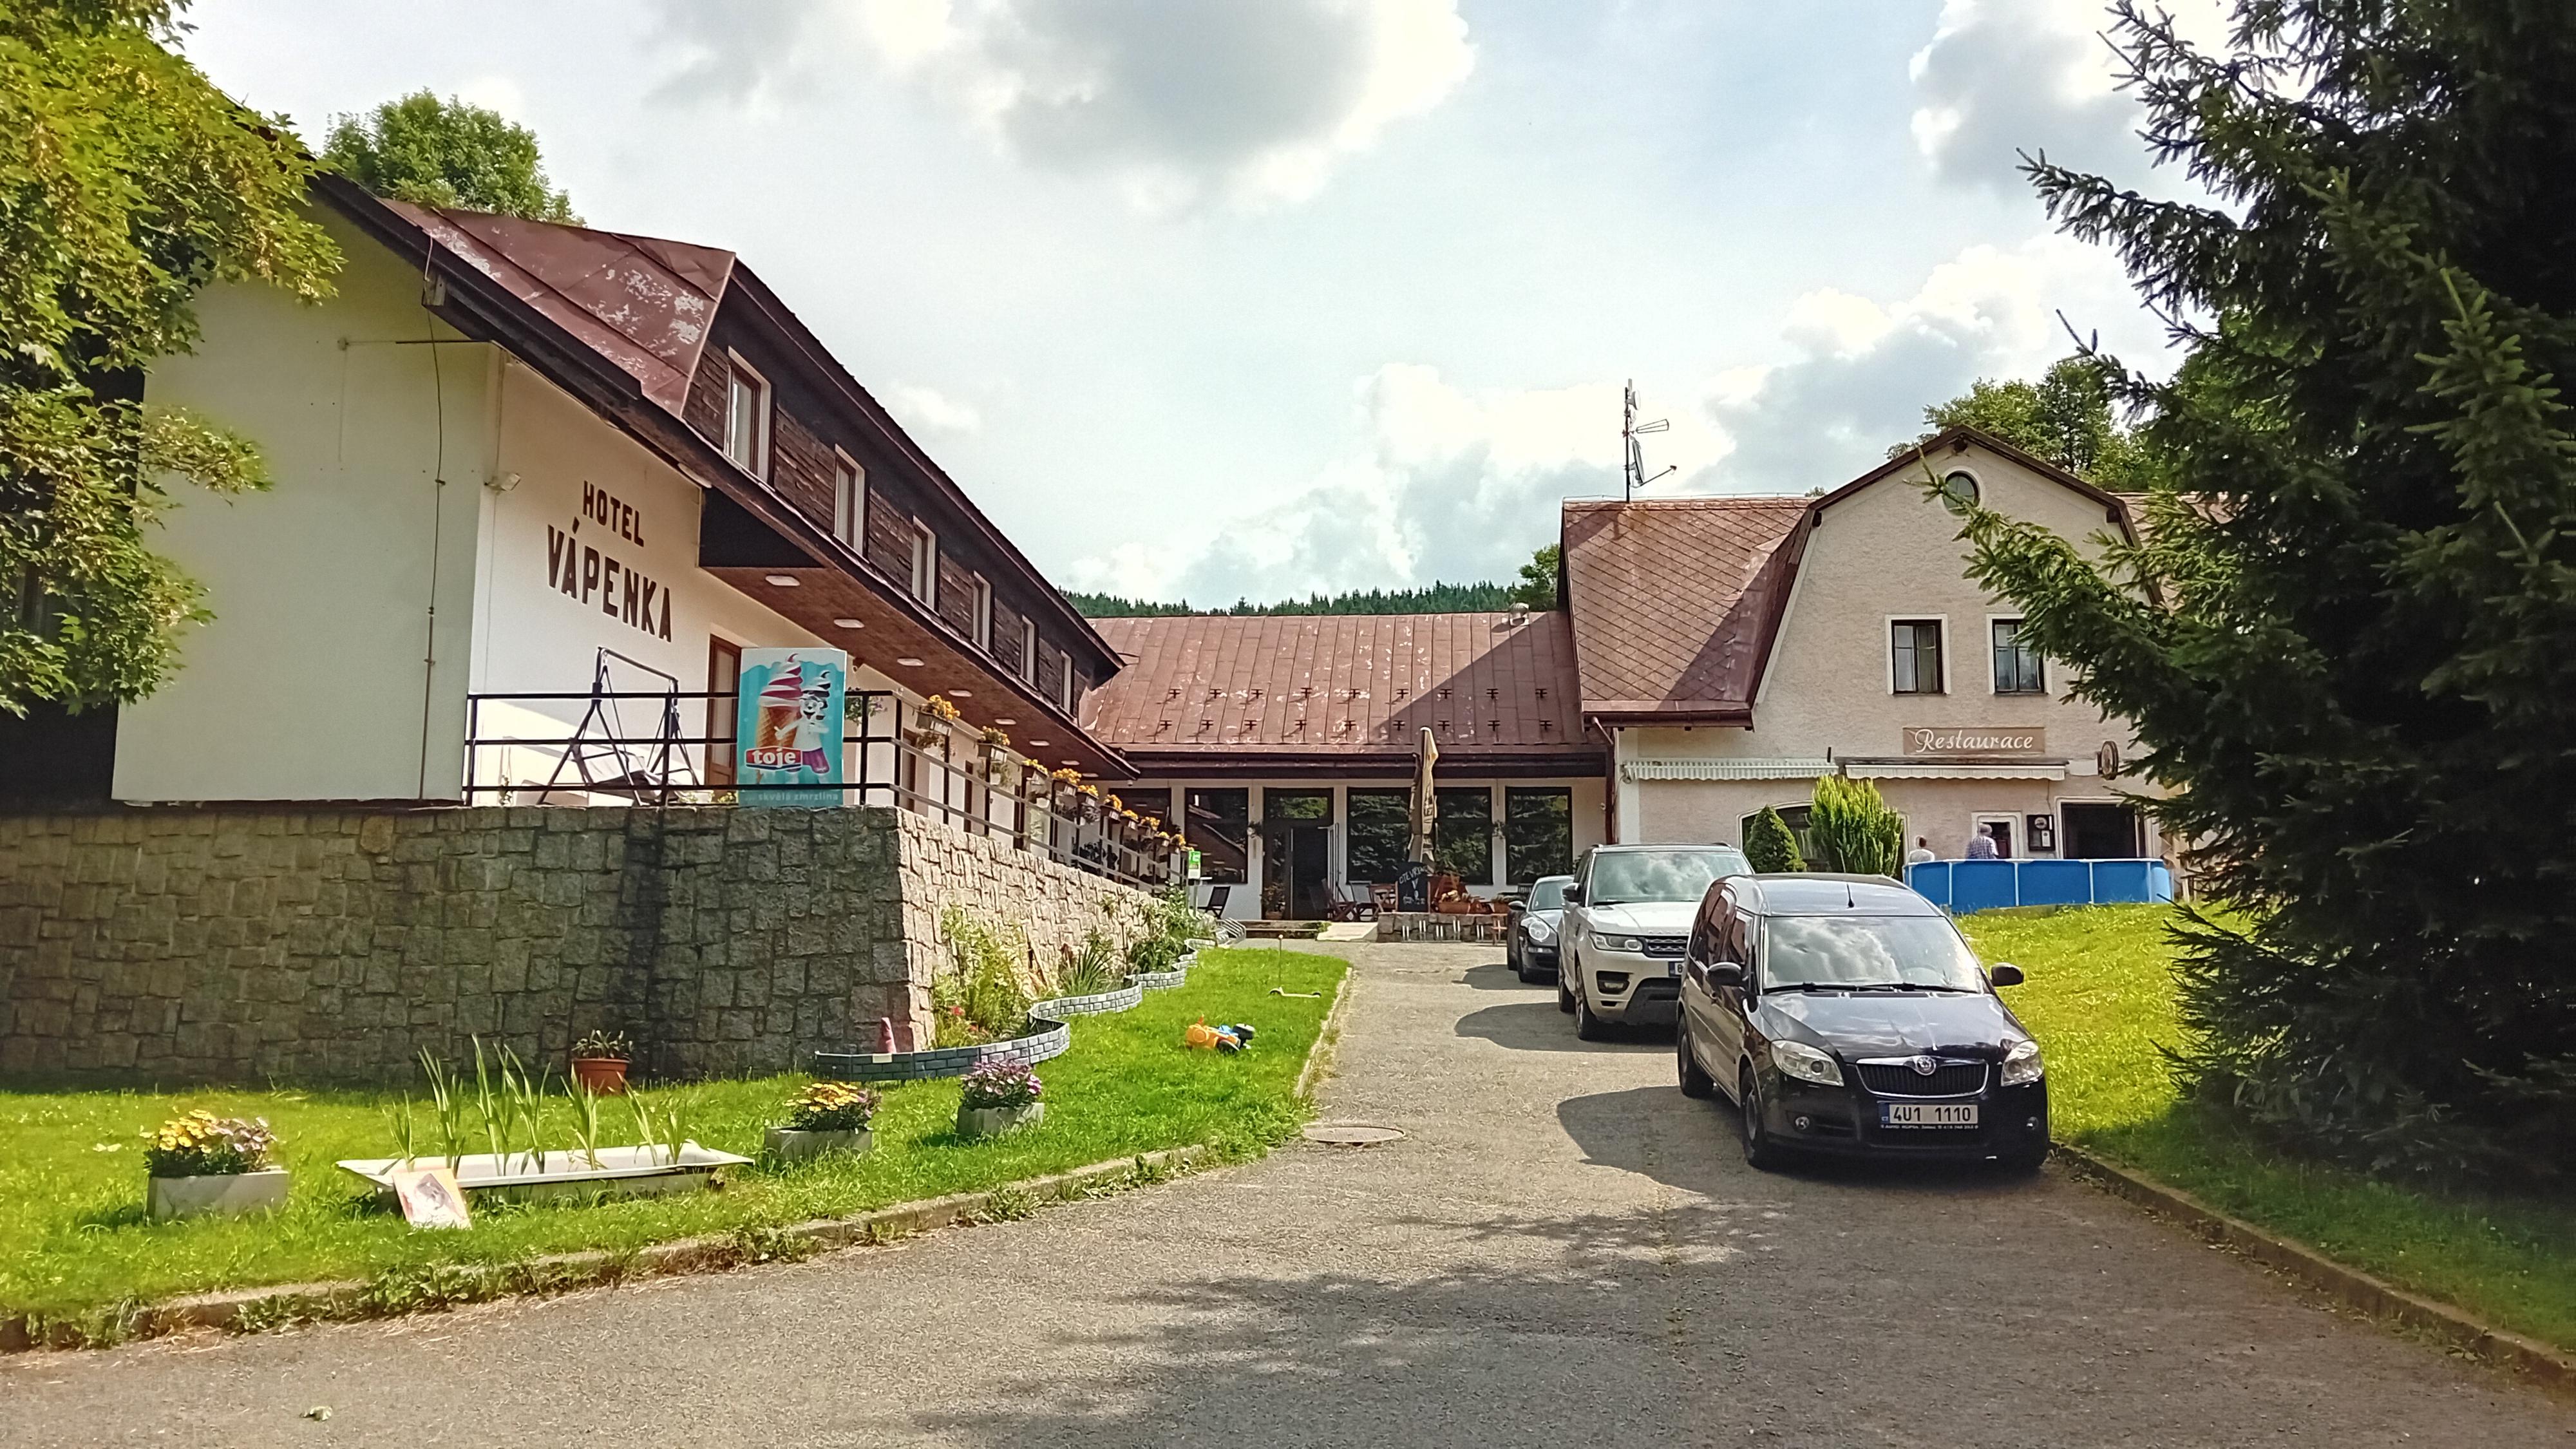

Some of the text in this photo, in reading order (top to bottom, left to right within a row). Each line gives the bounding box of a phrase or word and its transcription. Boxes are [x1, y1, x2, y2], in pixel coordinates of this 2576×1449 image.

[583, 480, 644, 547] HOTEL
[547, 516, 672, 643] VÁPENKA
[1914, 728, 2034, 753] Restaurace
[752, 747, 797, 768] toje
[794, 791, 838, 801] zmrzlina
[1893, 1106, 1971, 1122] 4U1 1110
